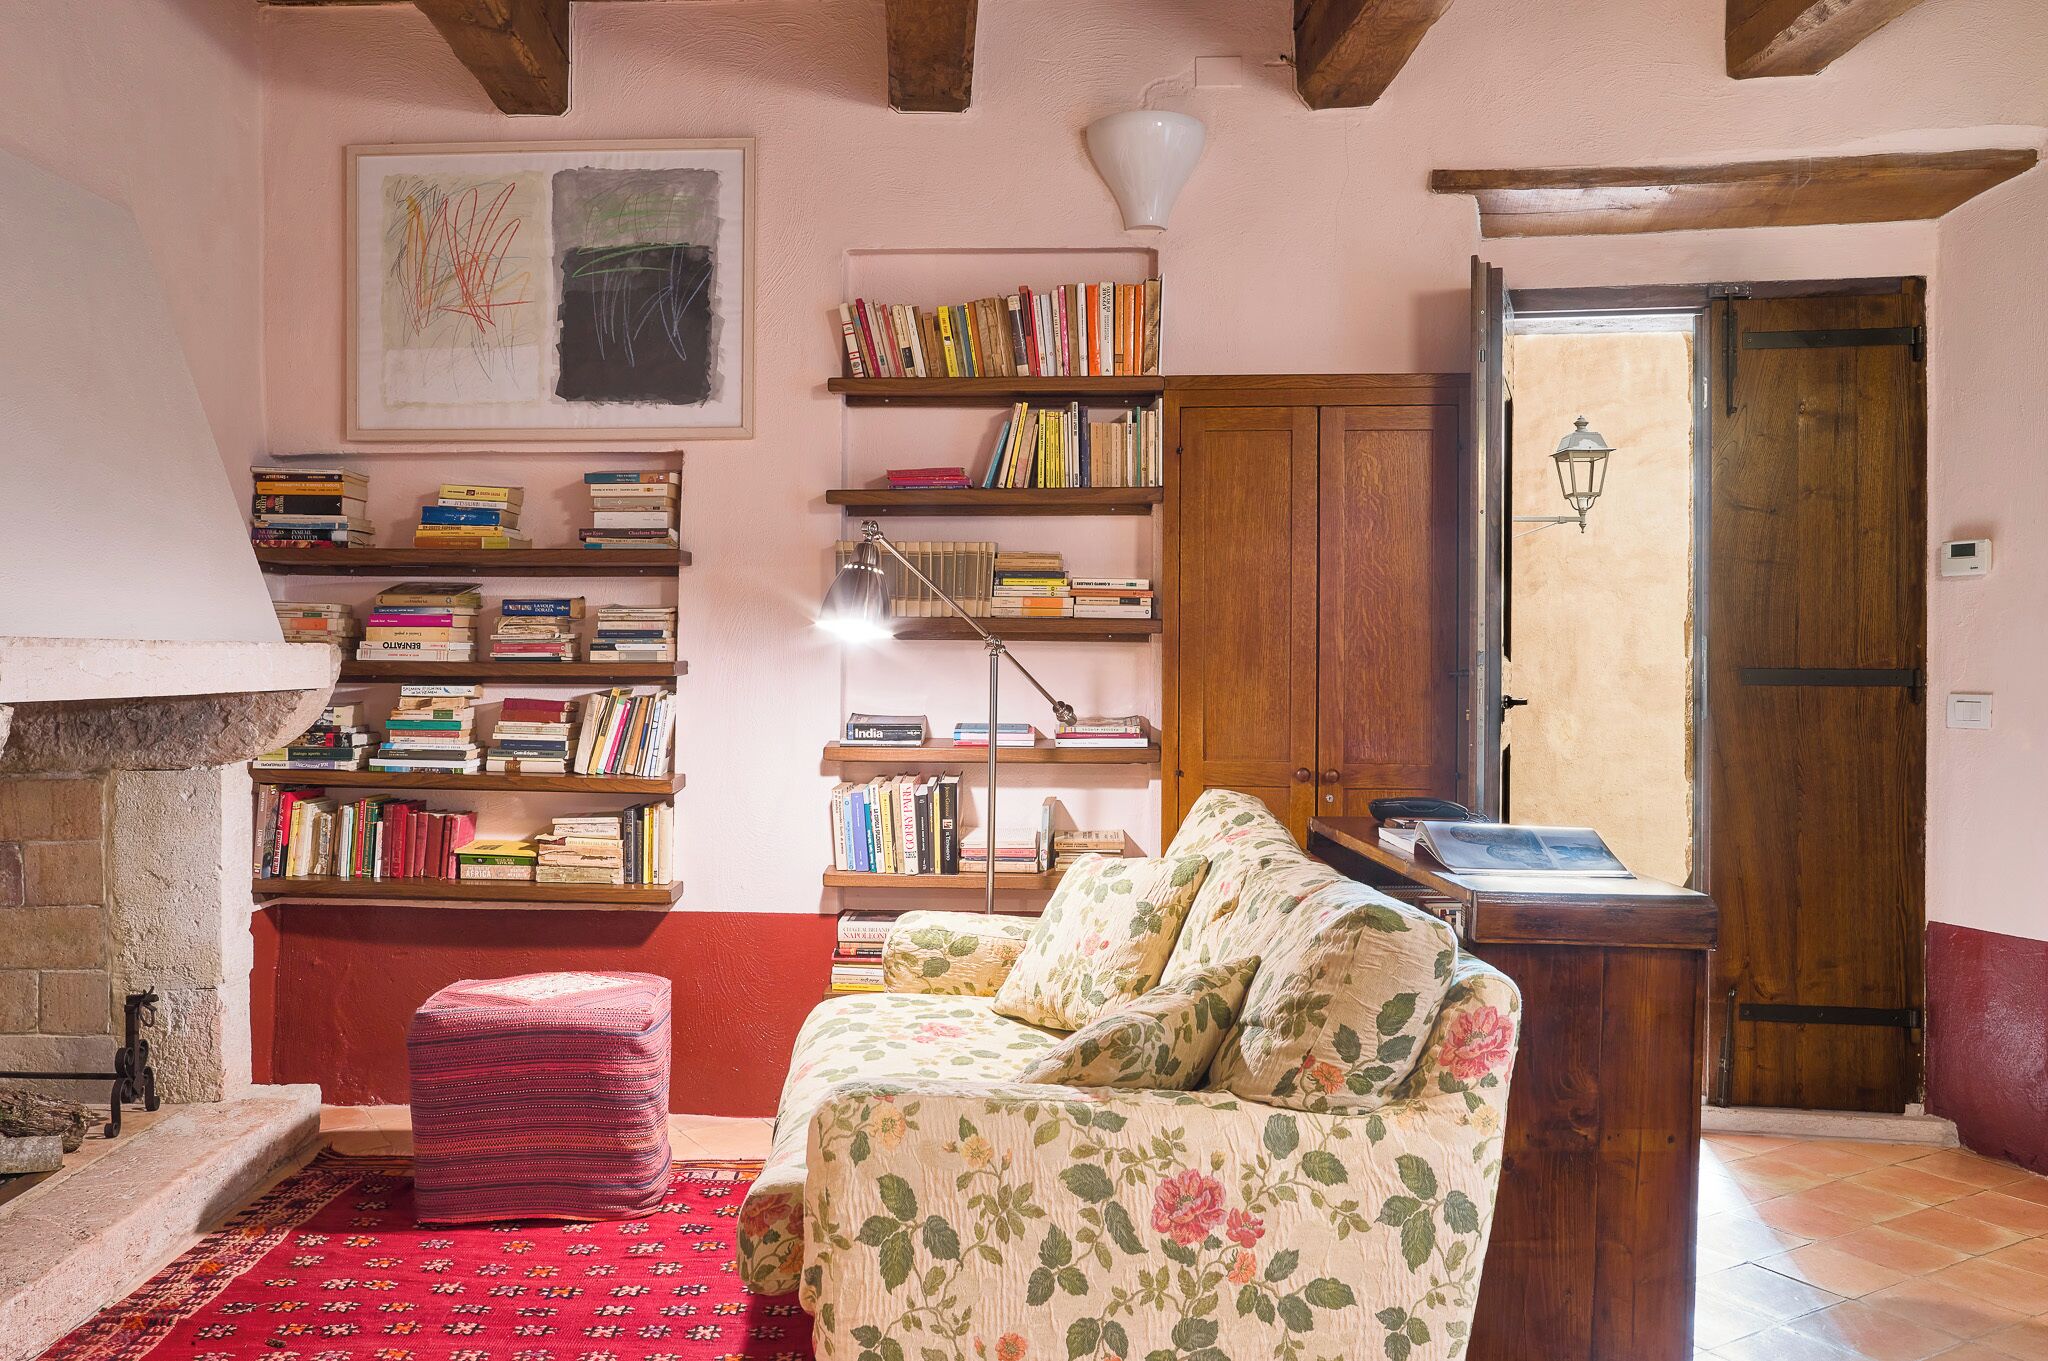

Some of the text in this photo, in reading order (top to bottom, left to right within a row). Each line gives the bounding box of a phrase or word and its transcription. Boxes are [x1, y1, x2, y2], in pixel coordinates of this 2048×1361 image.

[382, 642, 421, 650] BENFATTO
[854, 728, 884, 738] India
[902, 786, 912, 812] PARK
[904, 812, 915, 850] GORKY
